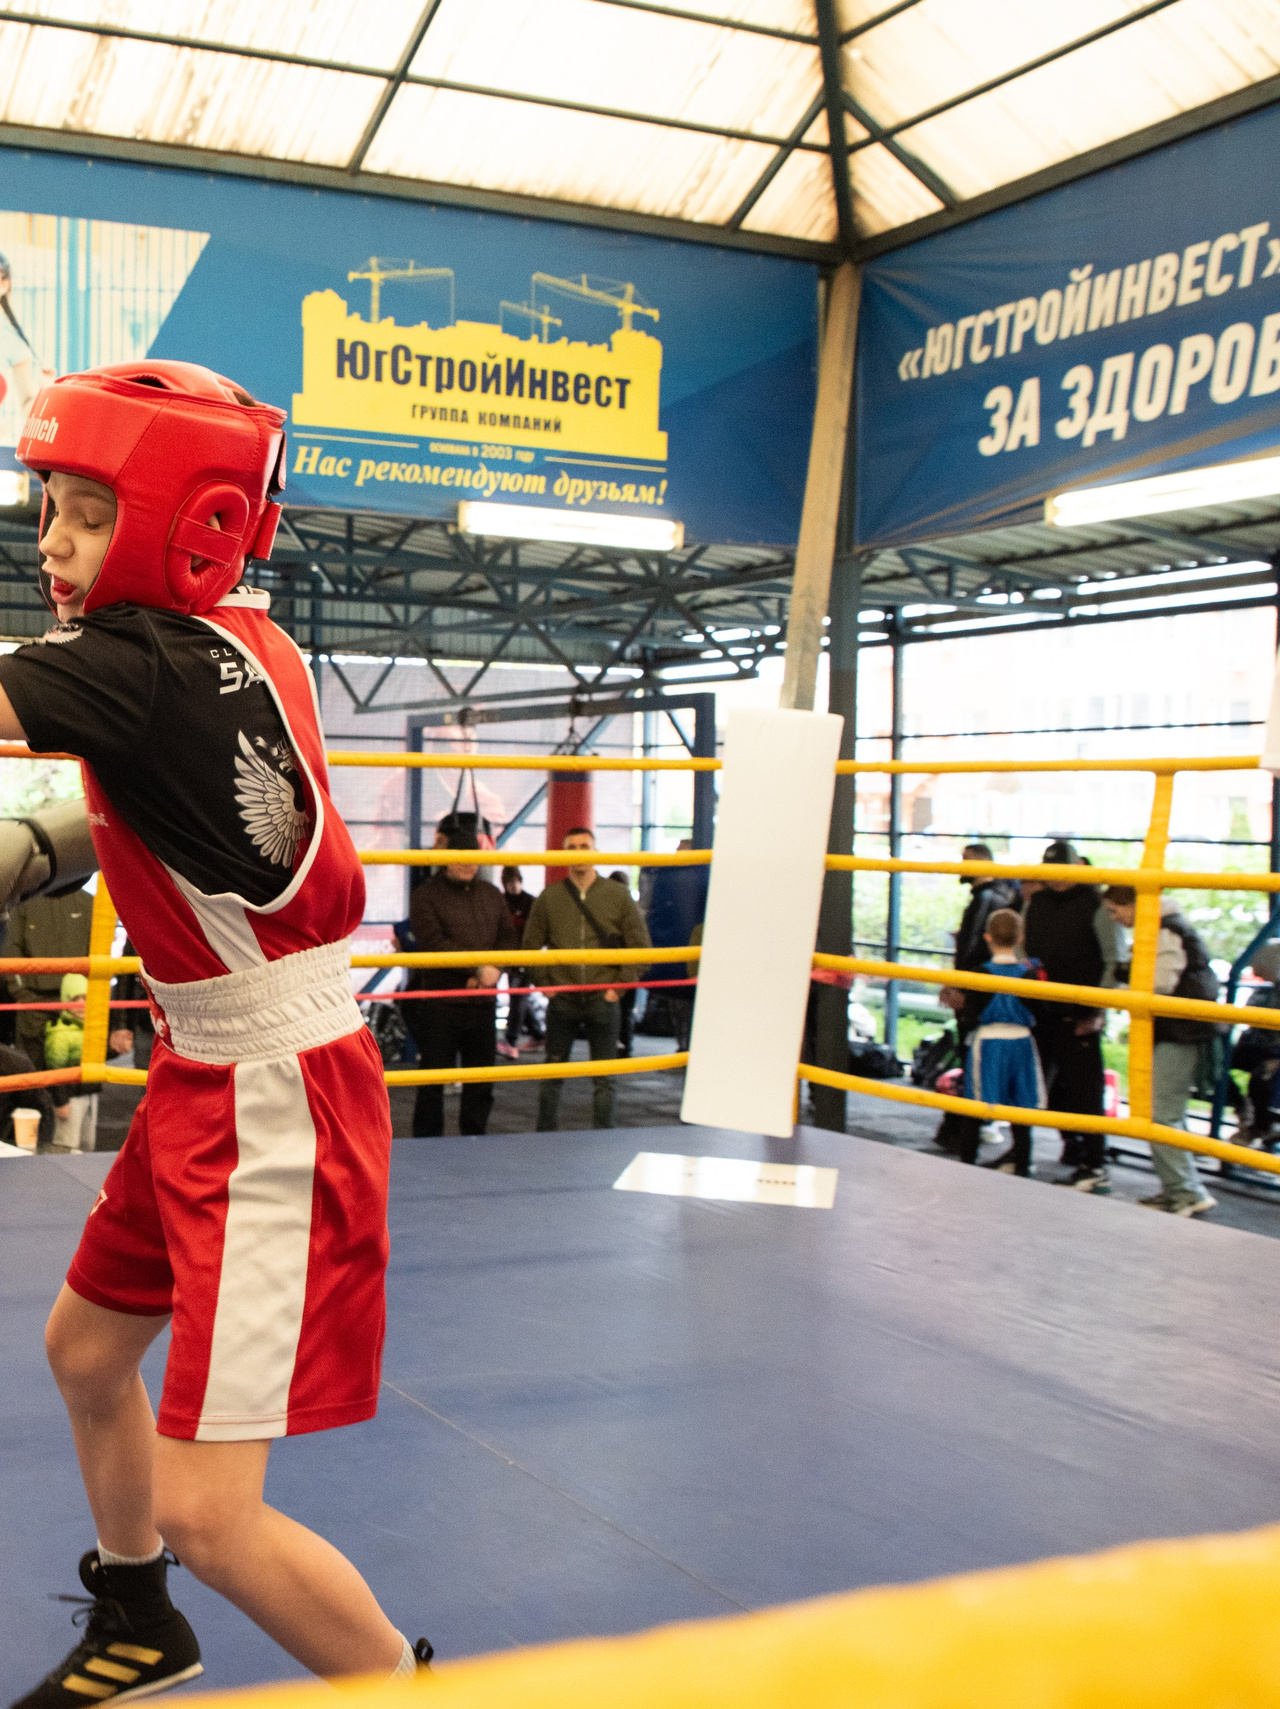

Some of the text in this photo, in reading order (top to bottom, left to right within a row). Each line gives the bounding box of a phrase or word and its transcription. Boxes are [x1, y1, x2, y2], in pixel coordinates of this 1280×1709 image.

[336, 338, 631, 410] ЮгСтройИнвест
[411, 404, 562, 433] ГРУППА КОМПАНИЙ
[978, 377, 1041, 456] ЗА
[293, 445, 668, 506] Нас рекомендуют друзьям!
